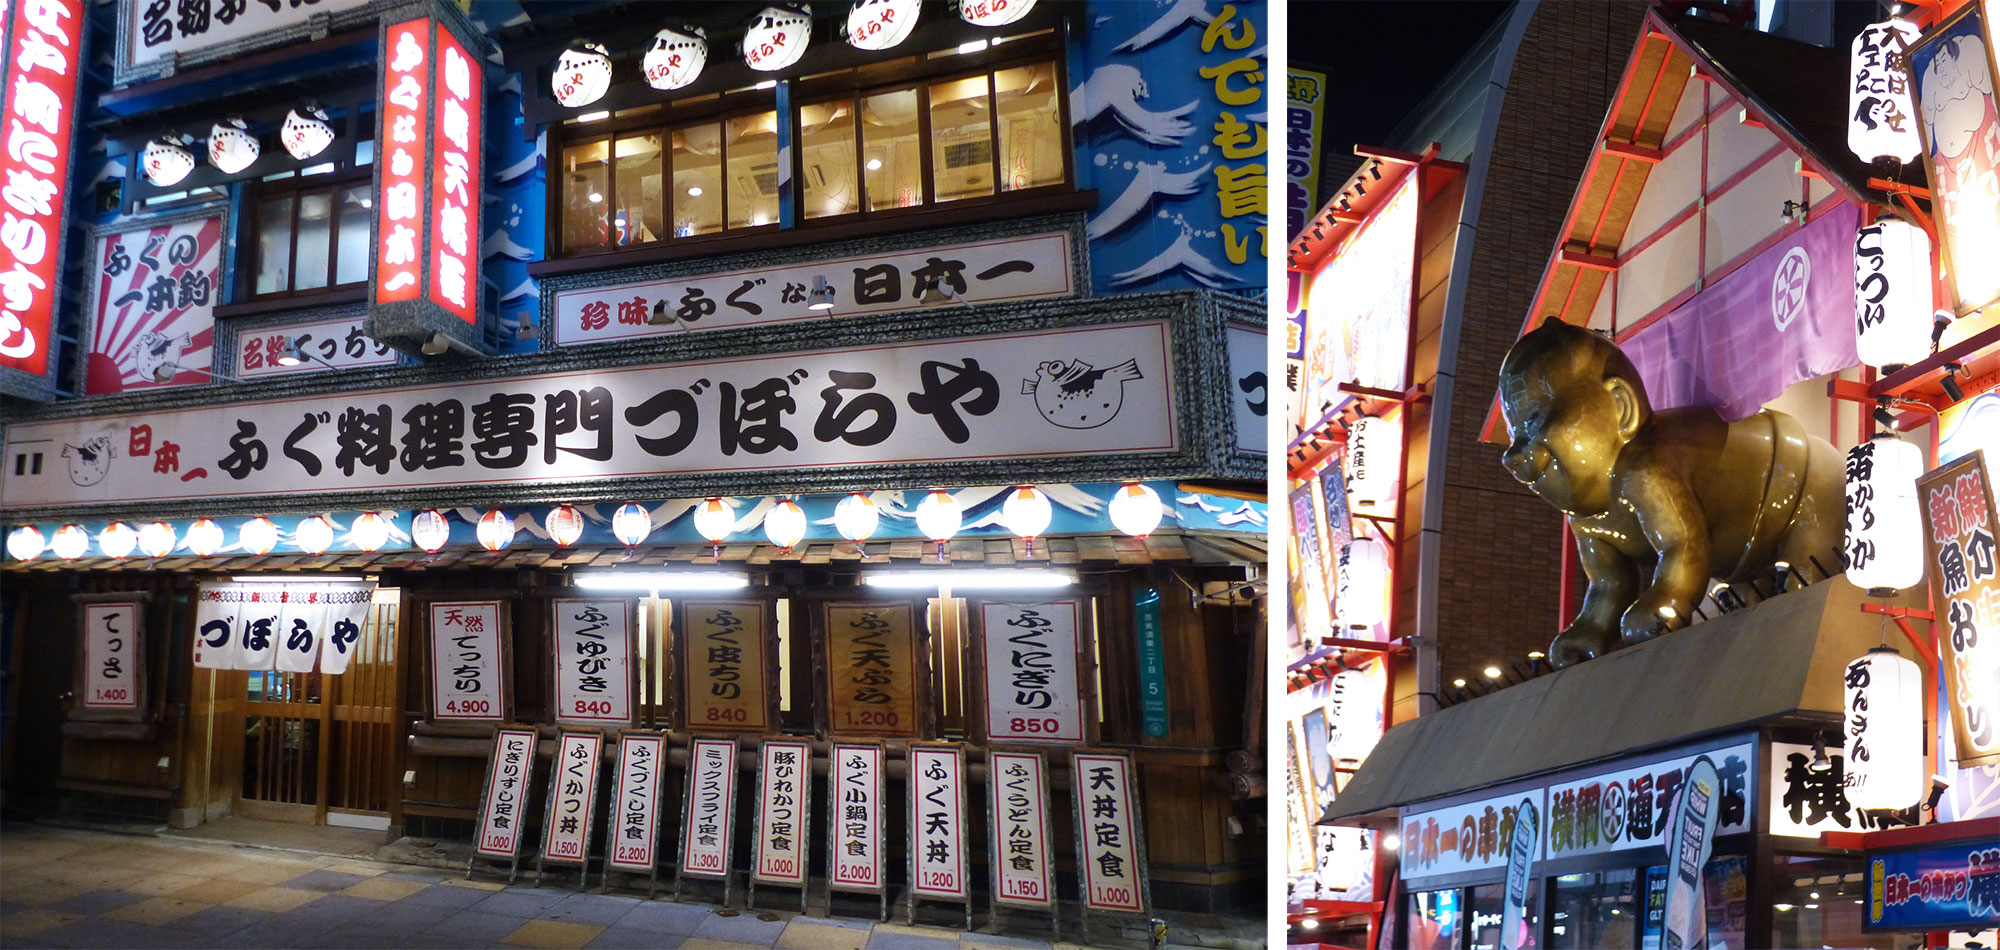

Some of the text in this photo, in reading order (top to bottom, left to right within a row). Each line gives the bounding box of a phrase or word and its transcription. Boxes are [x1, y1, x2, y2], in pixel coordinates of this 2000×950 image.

[104, 233, 197, 278] ふぐの
[114, 270, 211, 314] 一本釣
[580, 296, 648, 330] 珍味
[129, 358, 1000, 483] 日本一 ふぐ料理専門づぼらや
[102, 613, 122, 679] てっさ
[200, 615, 359, 654] づぼらや
[444, 609, 484, 633] 天然
[451, 635, 482, 694] てっちり
[574, 606, 610, 692] ふぐゆびき
[705, 609, 743, 700] ふぐ皮ちり
[850, 612, 893, 705] ふぐ天ぷら
[1007, 609, 1056, 710] ふぐにぎり
[574, 701, 612, 715] 840
[706, 708, 747, 723] 840
[1010, 718, 1059, 733] 850
[1149, 683, 1158, 695] 5
[1845, 659, 1872, 763] あんさん
[493, 740, 524, 829] にぎりずし定食
[560, 743, 588, 834] ふぐかつ丼
[624, 746, 651, 840] ふぐづくし定食
[697, 749, 722, 846] ミックスフライ定食
[770, 752, 796, 851] 豚ひれかつ定食
[845, 755, 868, 857] ふぐ小鍋定食
[925, 759, 949, 864] ふぐ天丼
[1005, 763, 1034, 871] ふぐうどん定食
[1089, 767, 1124, 878] 天丼定食
[1626, 755, 1747, 842] 通天店
[1404, 804, 1538, 872] 日本一の串か
